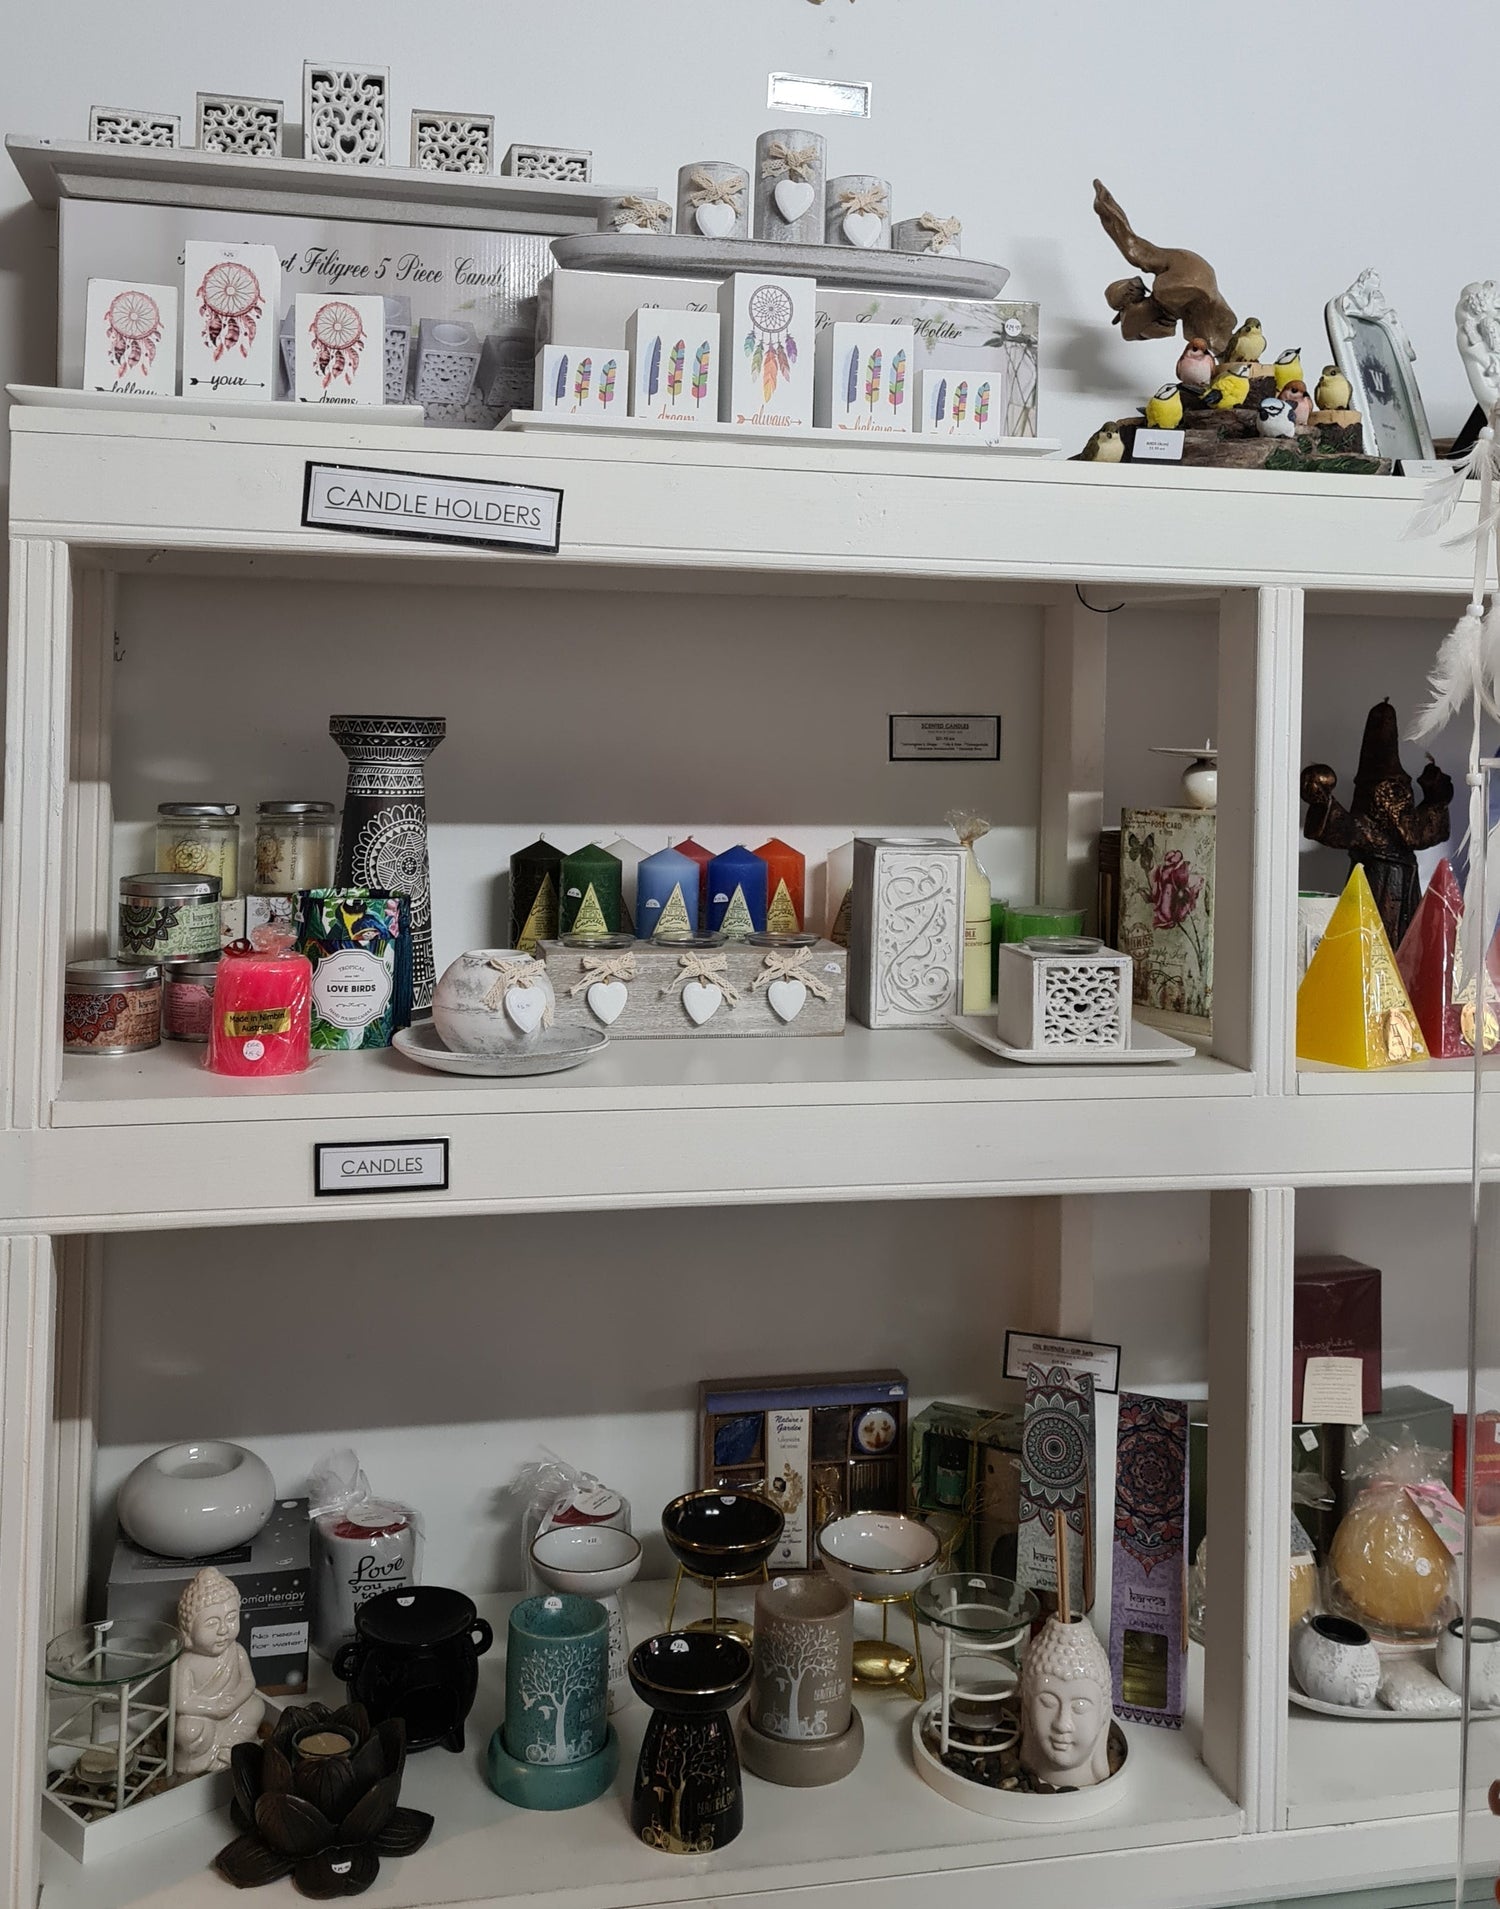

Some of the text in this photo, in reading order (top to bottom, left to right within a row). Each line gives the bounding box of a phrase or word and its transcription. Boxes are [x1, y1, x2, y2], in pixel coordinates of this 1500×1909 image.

[299, 246, 370, 285] Filigree
[374, 257, 392, 280] 5
[395, 253, 445, 283] Piece
[912, 317, 963, 339] Holder
[210, 375, 248, 391] your
[326, 486, 542, 527] CANDLE HOLDERS
[326, 984, 376, 993] LOVE BIRDS
[229, 1015, 249, 1023] Made
[250, 1014, 258, 1022] in
[241, 1023, 273, 1032] Australia
[341, 1157, 423, 1175] CANDLES
[776, 1423, 802, 1433] Garden
[348, 1555, 407, 1585] Love
[351, 1582, 382, 1594] you
[240, 1591, 306, 1606] omatherapy
[251, 1629, 302, 1640] No need
[251, 1642, 268, 1650] for
